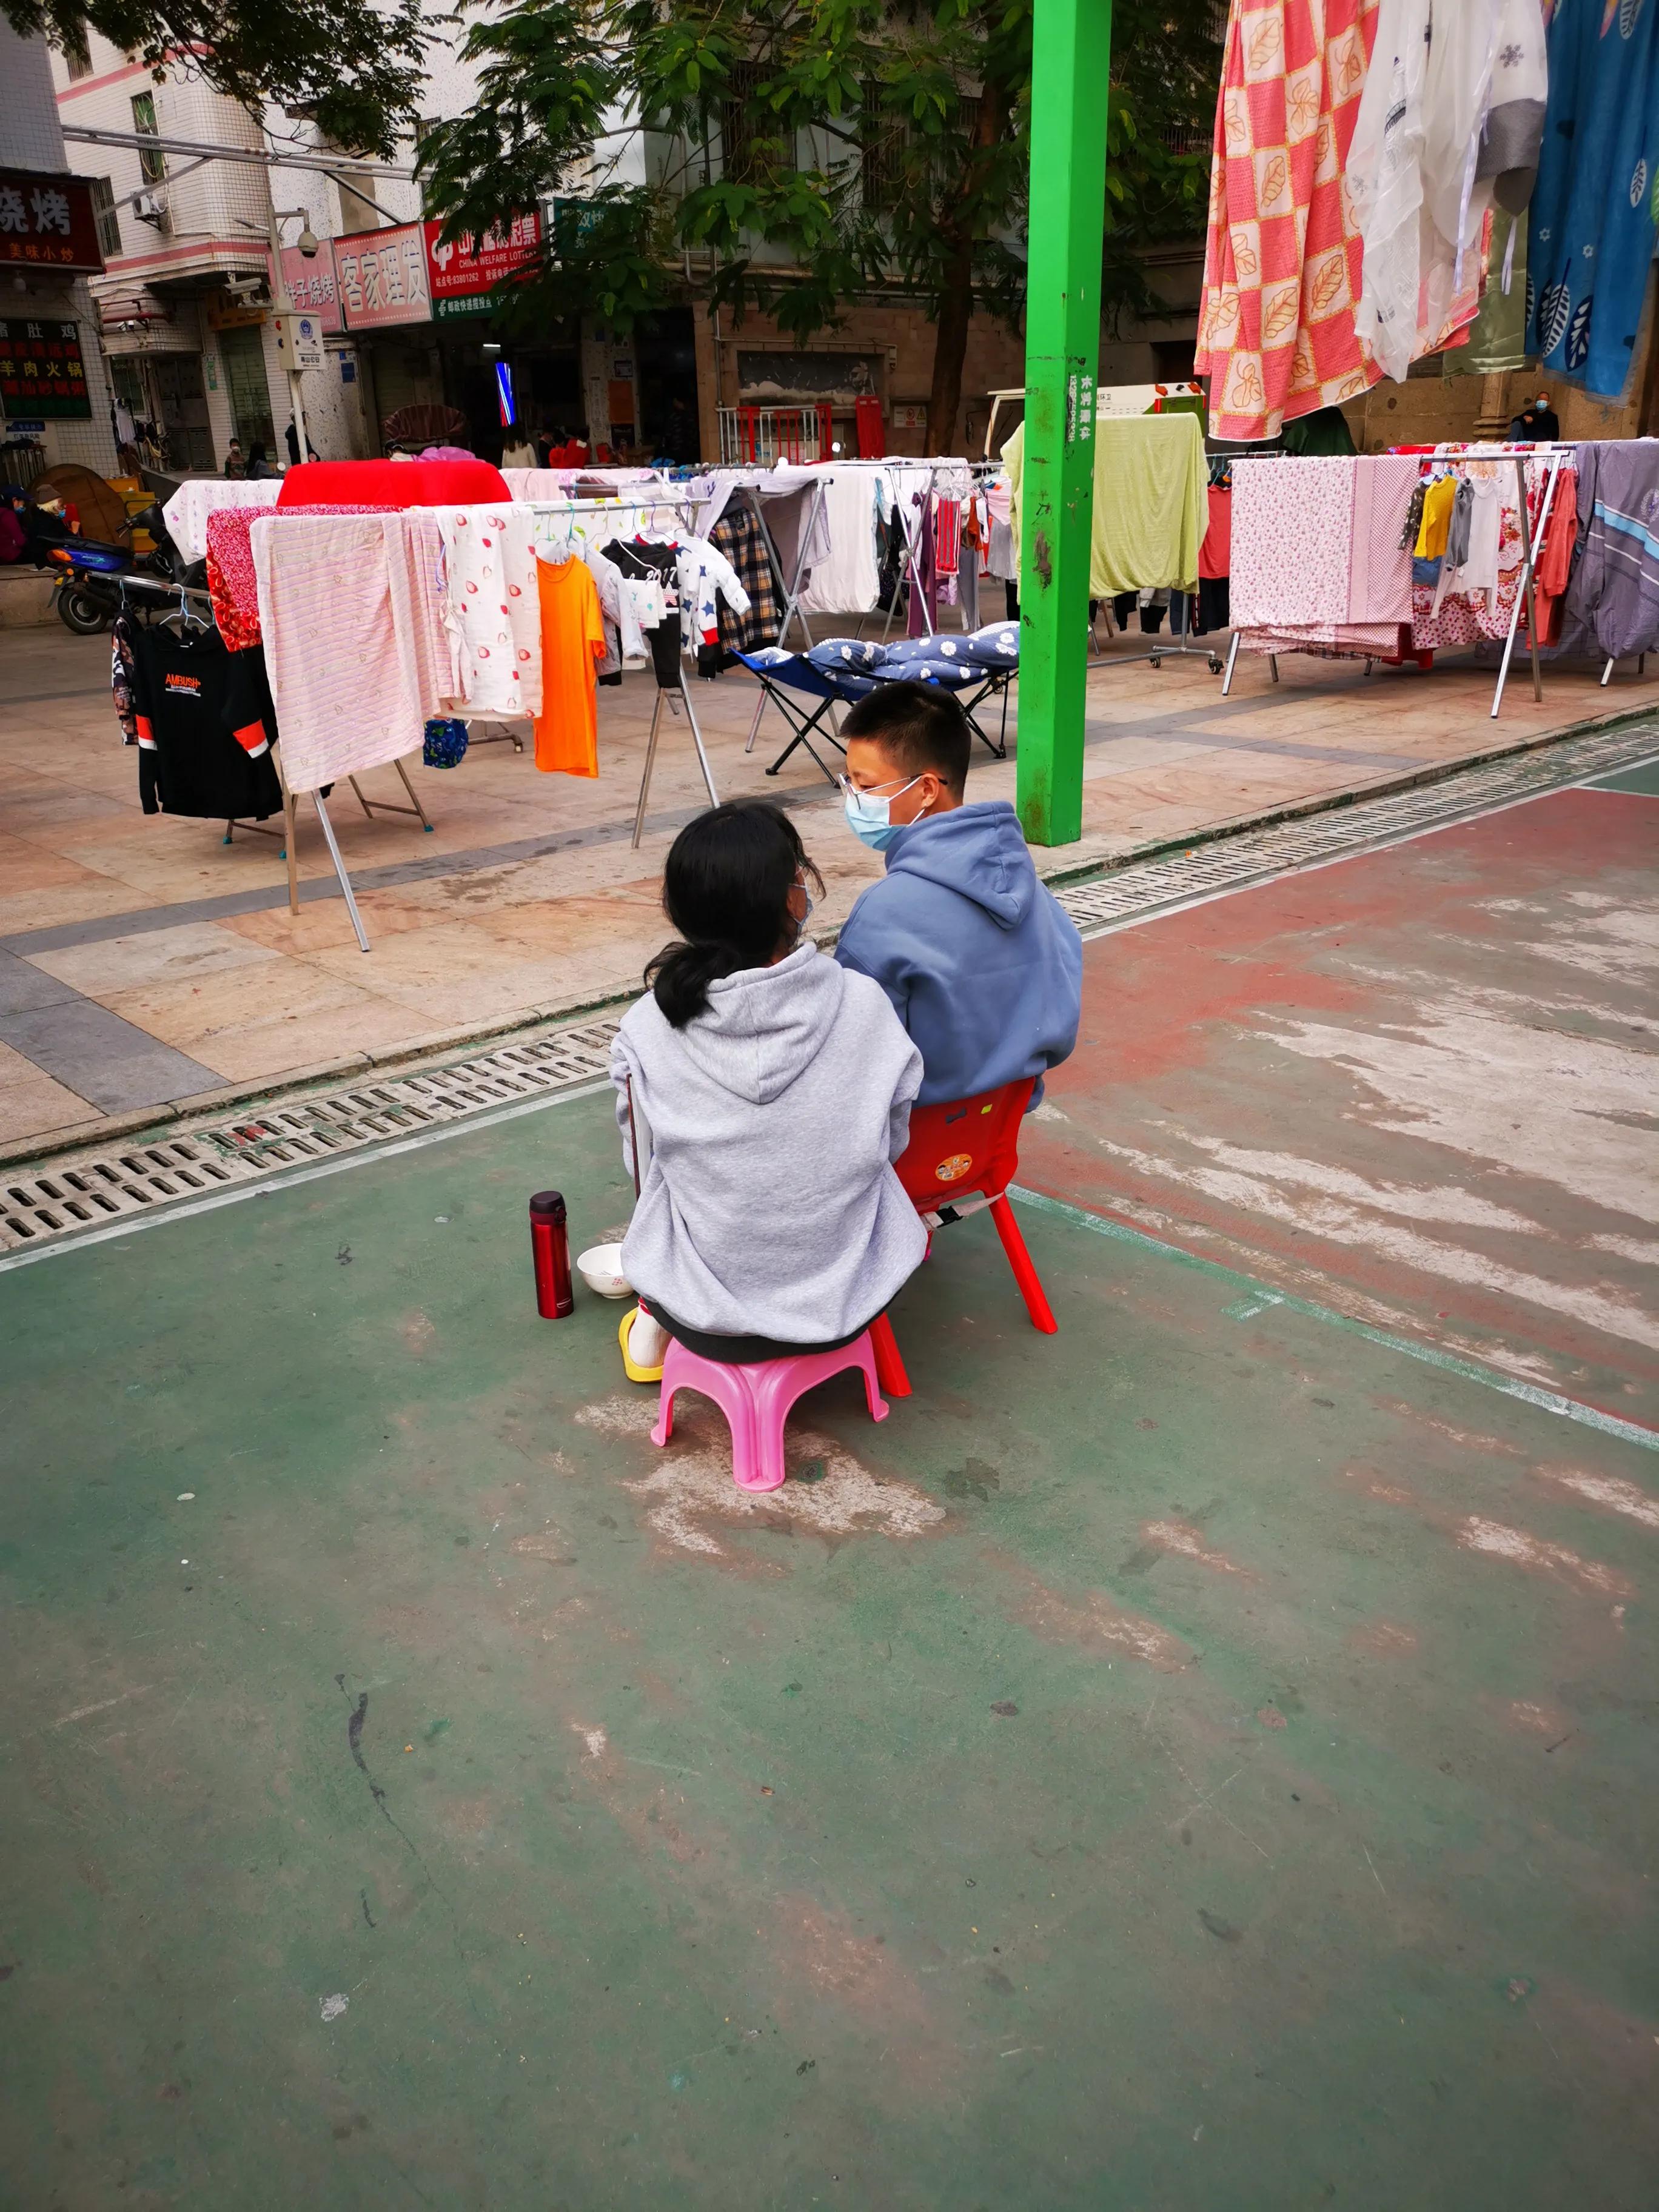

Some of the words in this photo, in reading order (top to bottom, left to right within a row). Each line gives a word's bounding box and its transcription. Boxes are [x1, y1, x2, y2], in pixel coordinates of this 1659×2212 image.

[10, 243, 74, 263] 美味小炒
[459, 258, 478, 269] CHINA
[480, 253, 507, 266] WELFARE
[509, 249, 537, 261] LOTTER
[341, 240, 427, 313] 客家理发
[0, 360, 83, 378] 羊肉火锅
[645, 566, 678, 586] 2017
[165, 673, 198, 689] AMBUSH
